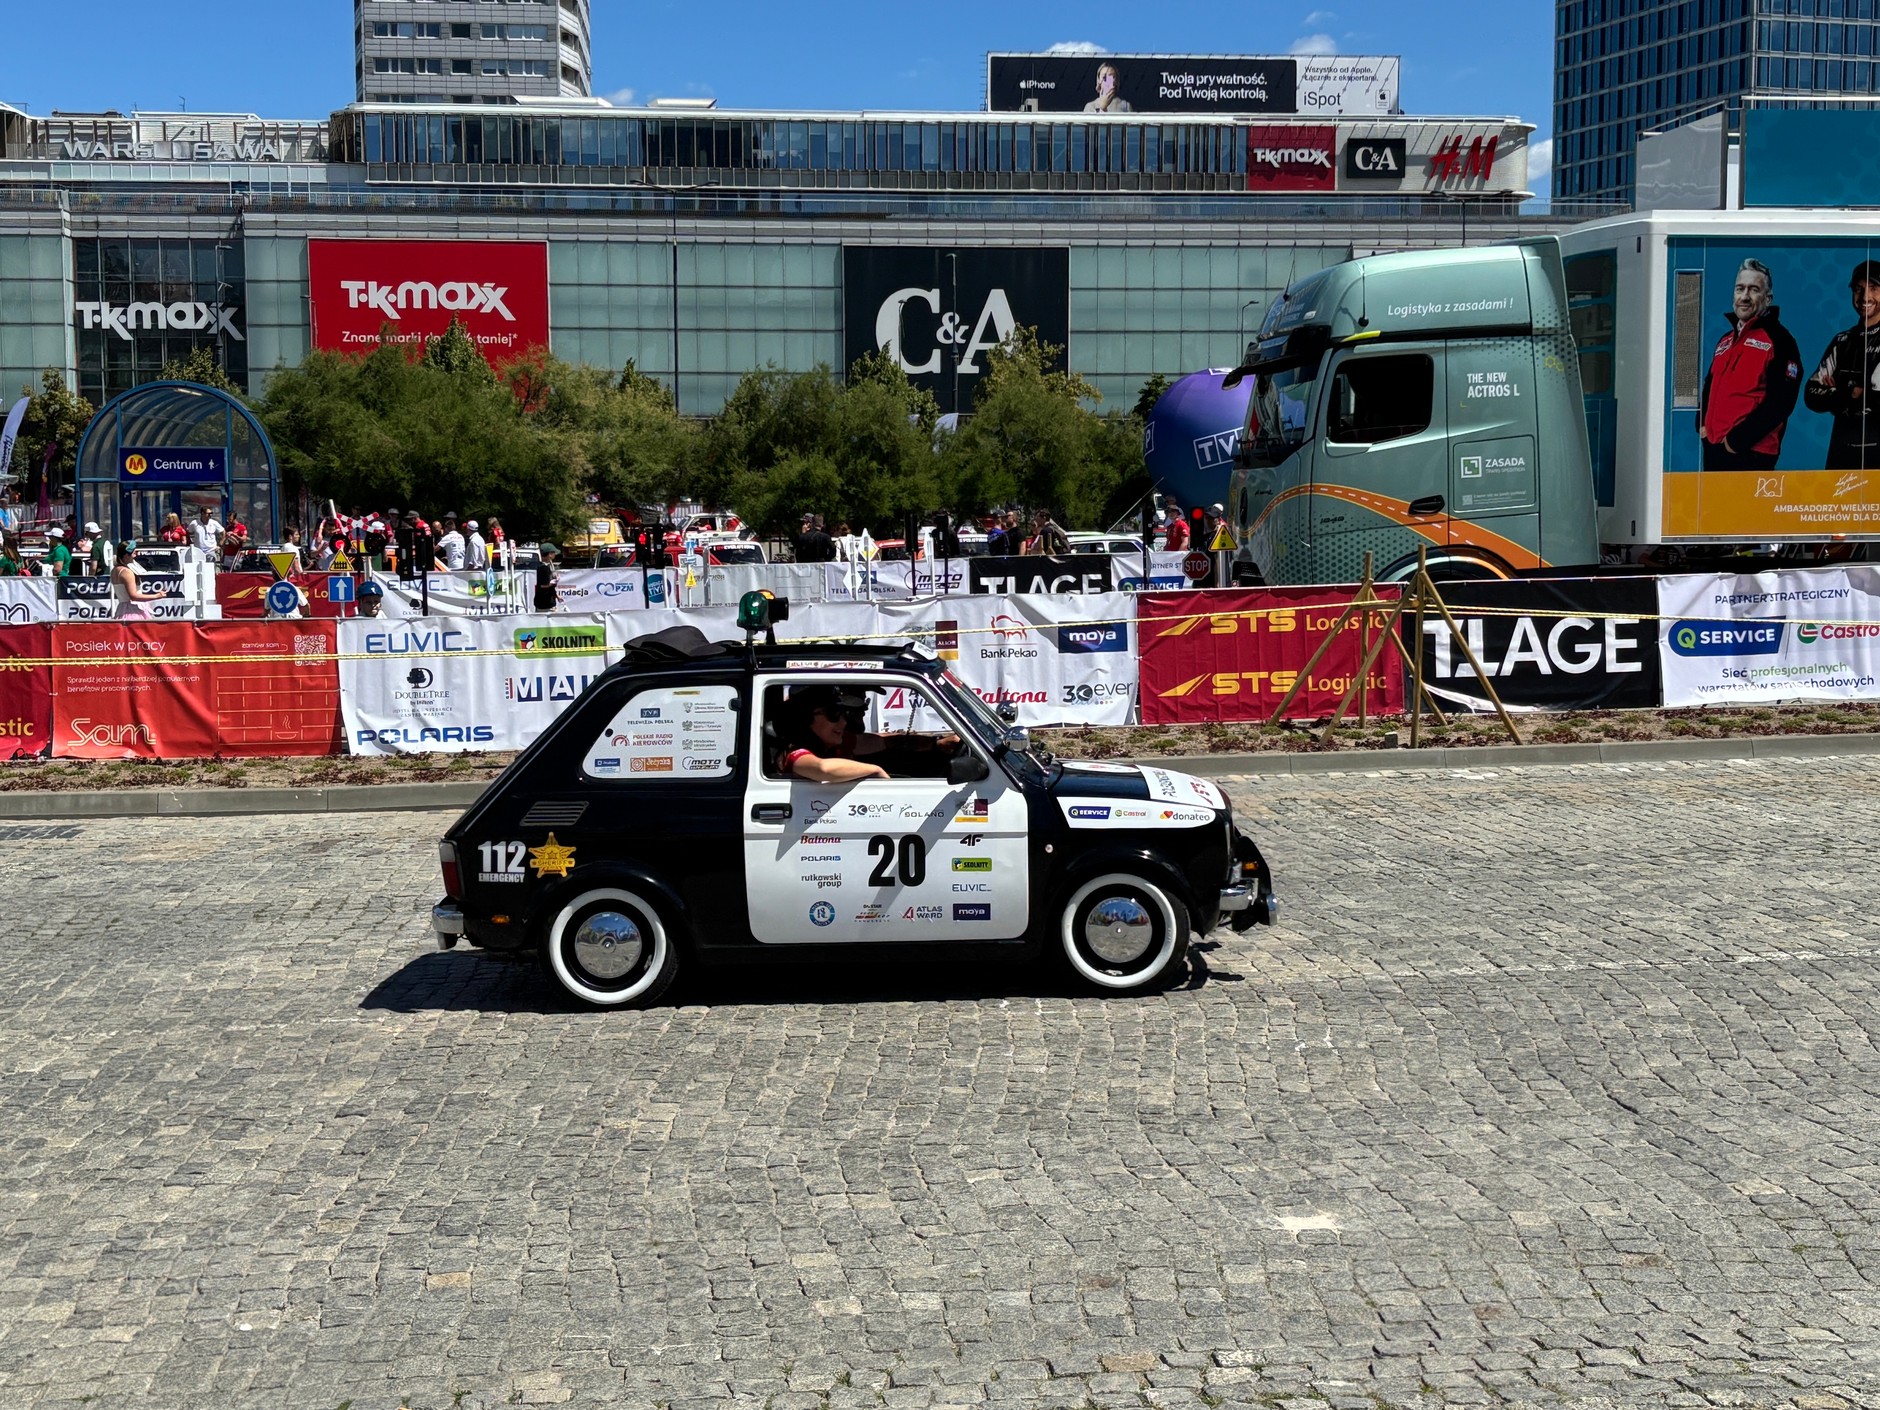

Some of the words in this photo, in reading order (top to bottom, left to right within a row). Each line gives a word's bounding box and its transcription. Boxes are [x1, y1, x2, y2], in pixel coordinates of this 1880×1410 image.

[1026, 80, 1056, 89] iPhone
[1160, 71, 1194, 85] Twoja
[1195, 71, 1268, 87] prywatność.
[1159, 87, 1182, 99] Pod
[1183, 87, 1218, 100] Twoją
[1219, 87, 1269, 102] kontrolą.
[1303, 91, 1342, 109] iSpot
[1355, 146, 1398, 171] C&A
[1430, 135, 1498, 181] H&M
[1387, 302, 1442, 318] Logistyka
[1444, 303, 1451, 312] z
[1453, 298, 1507, 312] zasadami
[341, 331, 381, 343] Znane
[875, 288, 1017, 374] C&A
[1467, 373, 1484, 383] THE
[1486, 372, 1507, 383] NEW
[1467, 384, 1511, 398] ACTROS
[1513, 384, 1520, 396] L
[1198, 430, 1243, 462] TV
[153, 458, 203, 470] Centrum
[1485, 457, 1526, 468] ZASADA
[1773, 504, 1839, 513] AMBASADORZY
[1800, 512, 1851, 522] MALUCHÓW
[1853, 513, 1870, 521] DLA
[1184, 560, 1209, 572] STOP
[1714, 594, 1768, 605] PARTNER
[1769, 589, 1850, 602] STRATEGICZNY
[1210, 609, 1297, 635] STS
[541, 634, 596, 649] SKOLNITY
[1068, 630, 1118, 646] moya
[1699, 628, 1776, 645] SERVICE
[114, 642, 125, 651] w
[127, 641, 167, 653] pracy
[1722, 668, 1748, 679] Sieć
[1750, 662, 1848, 680] profesjonalnych
[1212, 670, 1298, 695] STS
[355, 725, 494, 746] POLARIS
[1172, 811, 1211, 821] donateo
[800, 835, 841, 845] Baltona
[477, 840, 527, 873] 112
[867, 833, 926, 888] 20
[478, 872, 526, 883] EMERGENCY
[801, 873, 842, 881] rutkowski
[817, 880, 842, 889] group
[958, 908, 985, 916] moya
